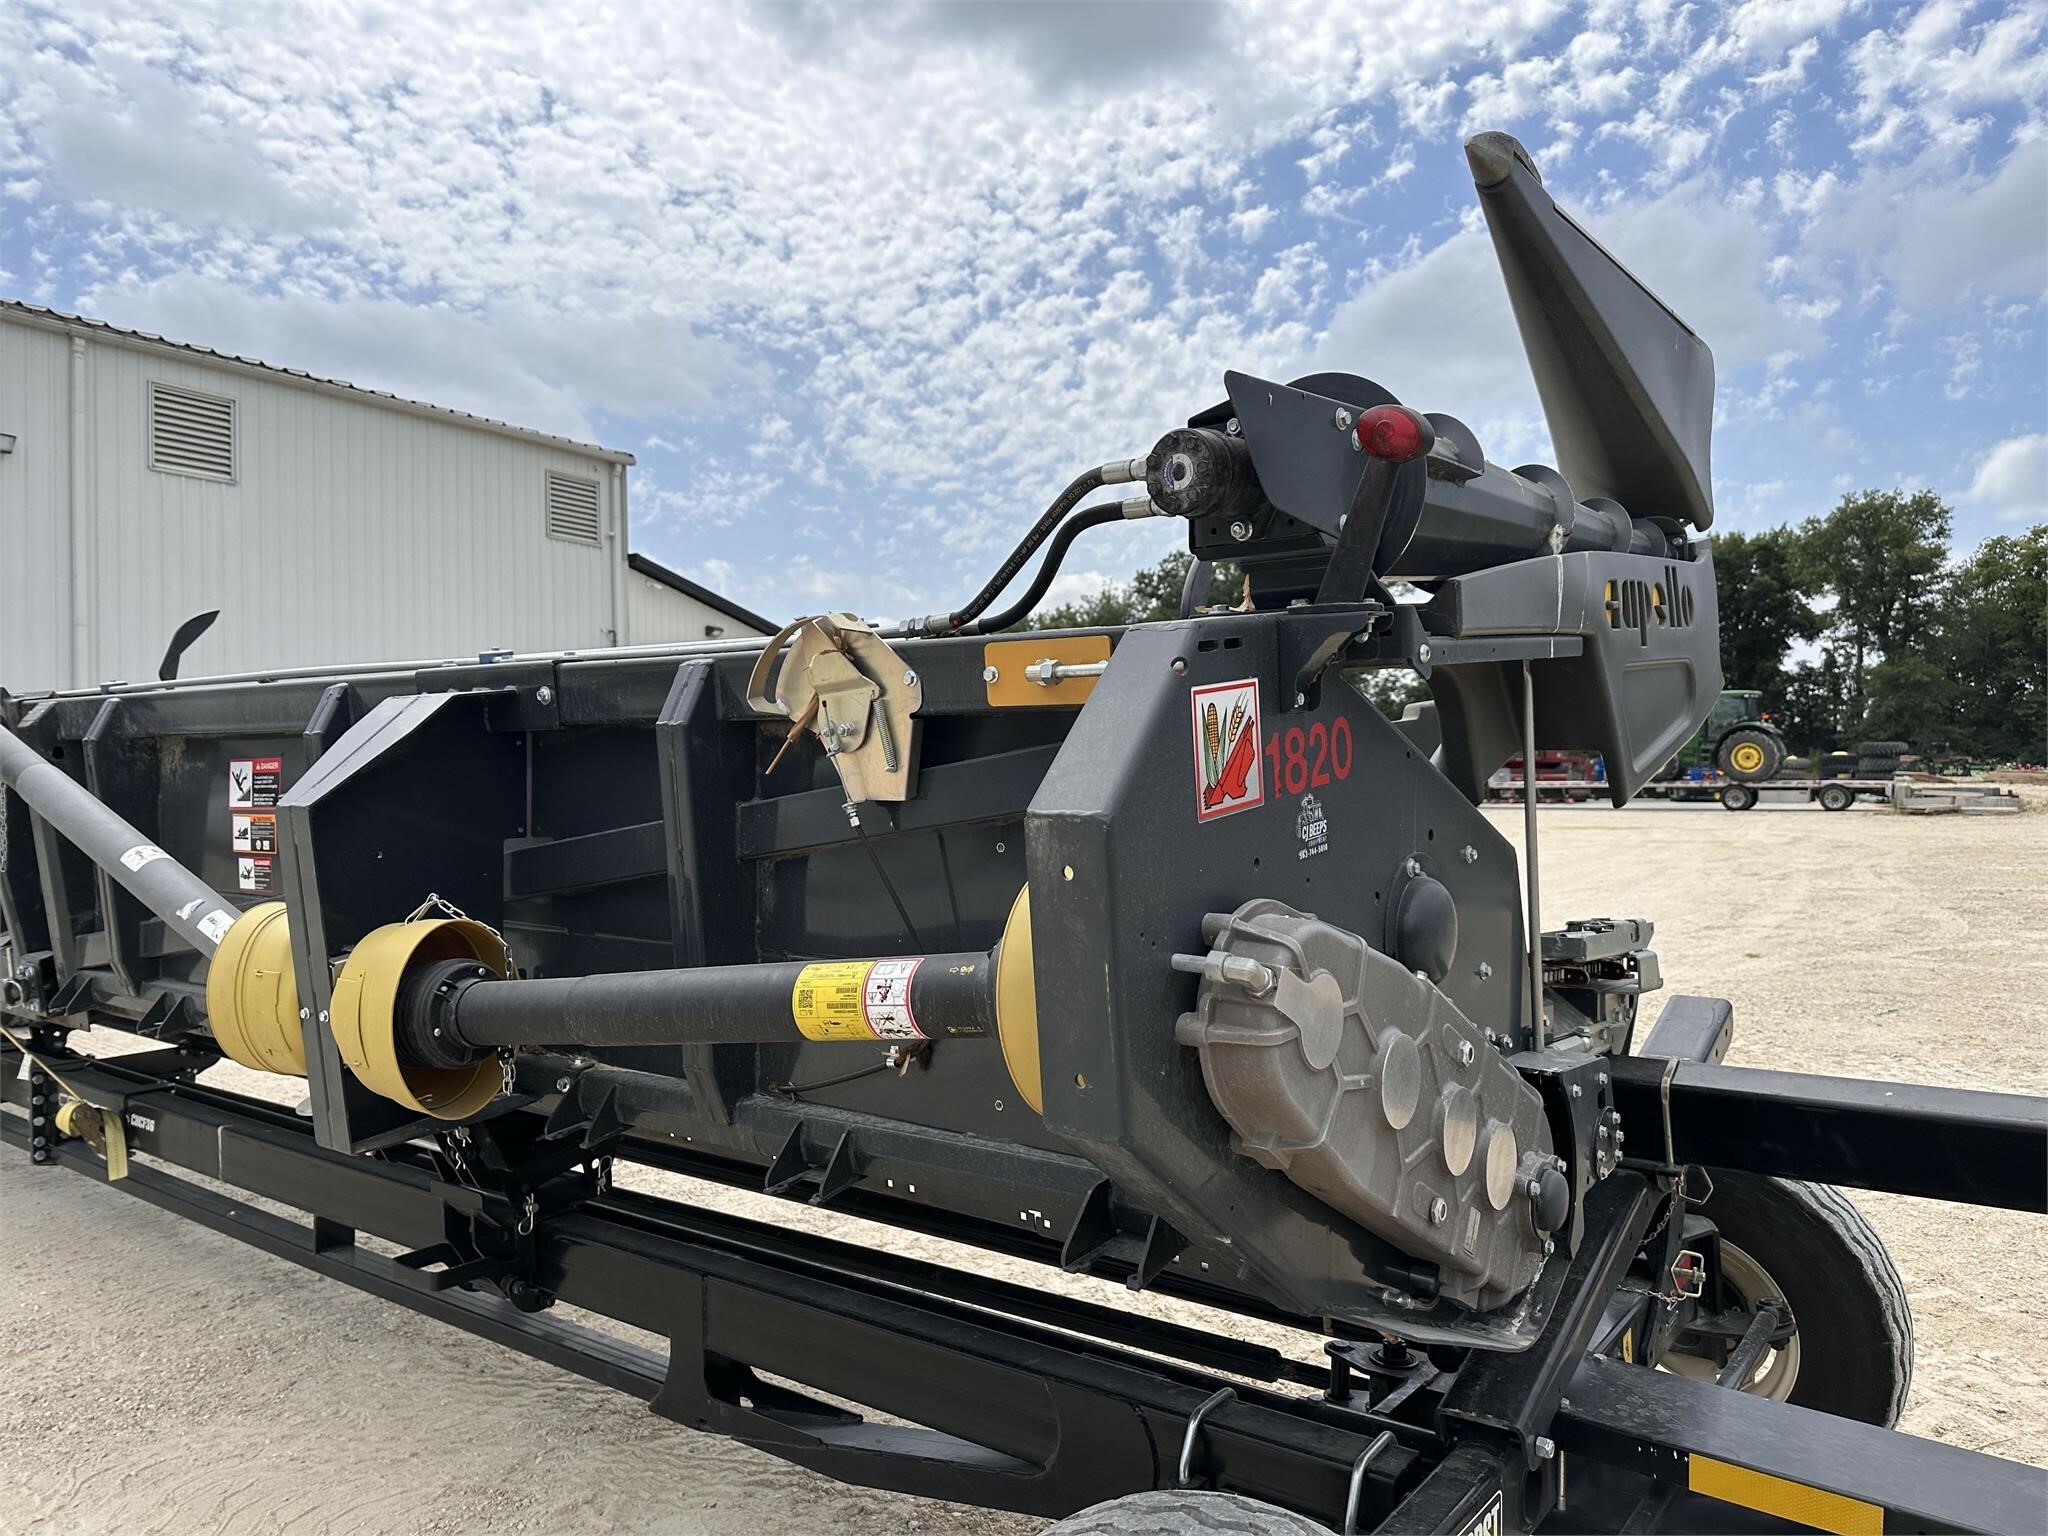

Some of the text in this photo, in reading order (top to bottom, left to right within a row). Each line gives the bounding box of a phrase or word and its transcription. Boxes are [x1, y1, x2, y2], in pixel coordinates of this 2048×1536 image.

[260, 762, 279, 770] DANGER
[1265, 716, 1353, 800] 1820
[1302, 819, 1328, 842] CJ BEEPS
